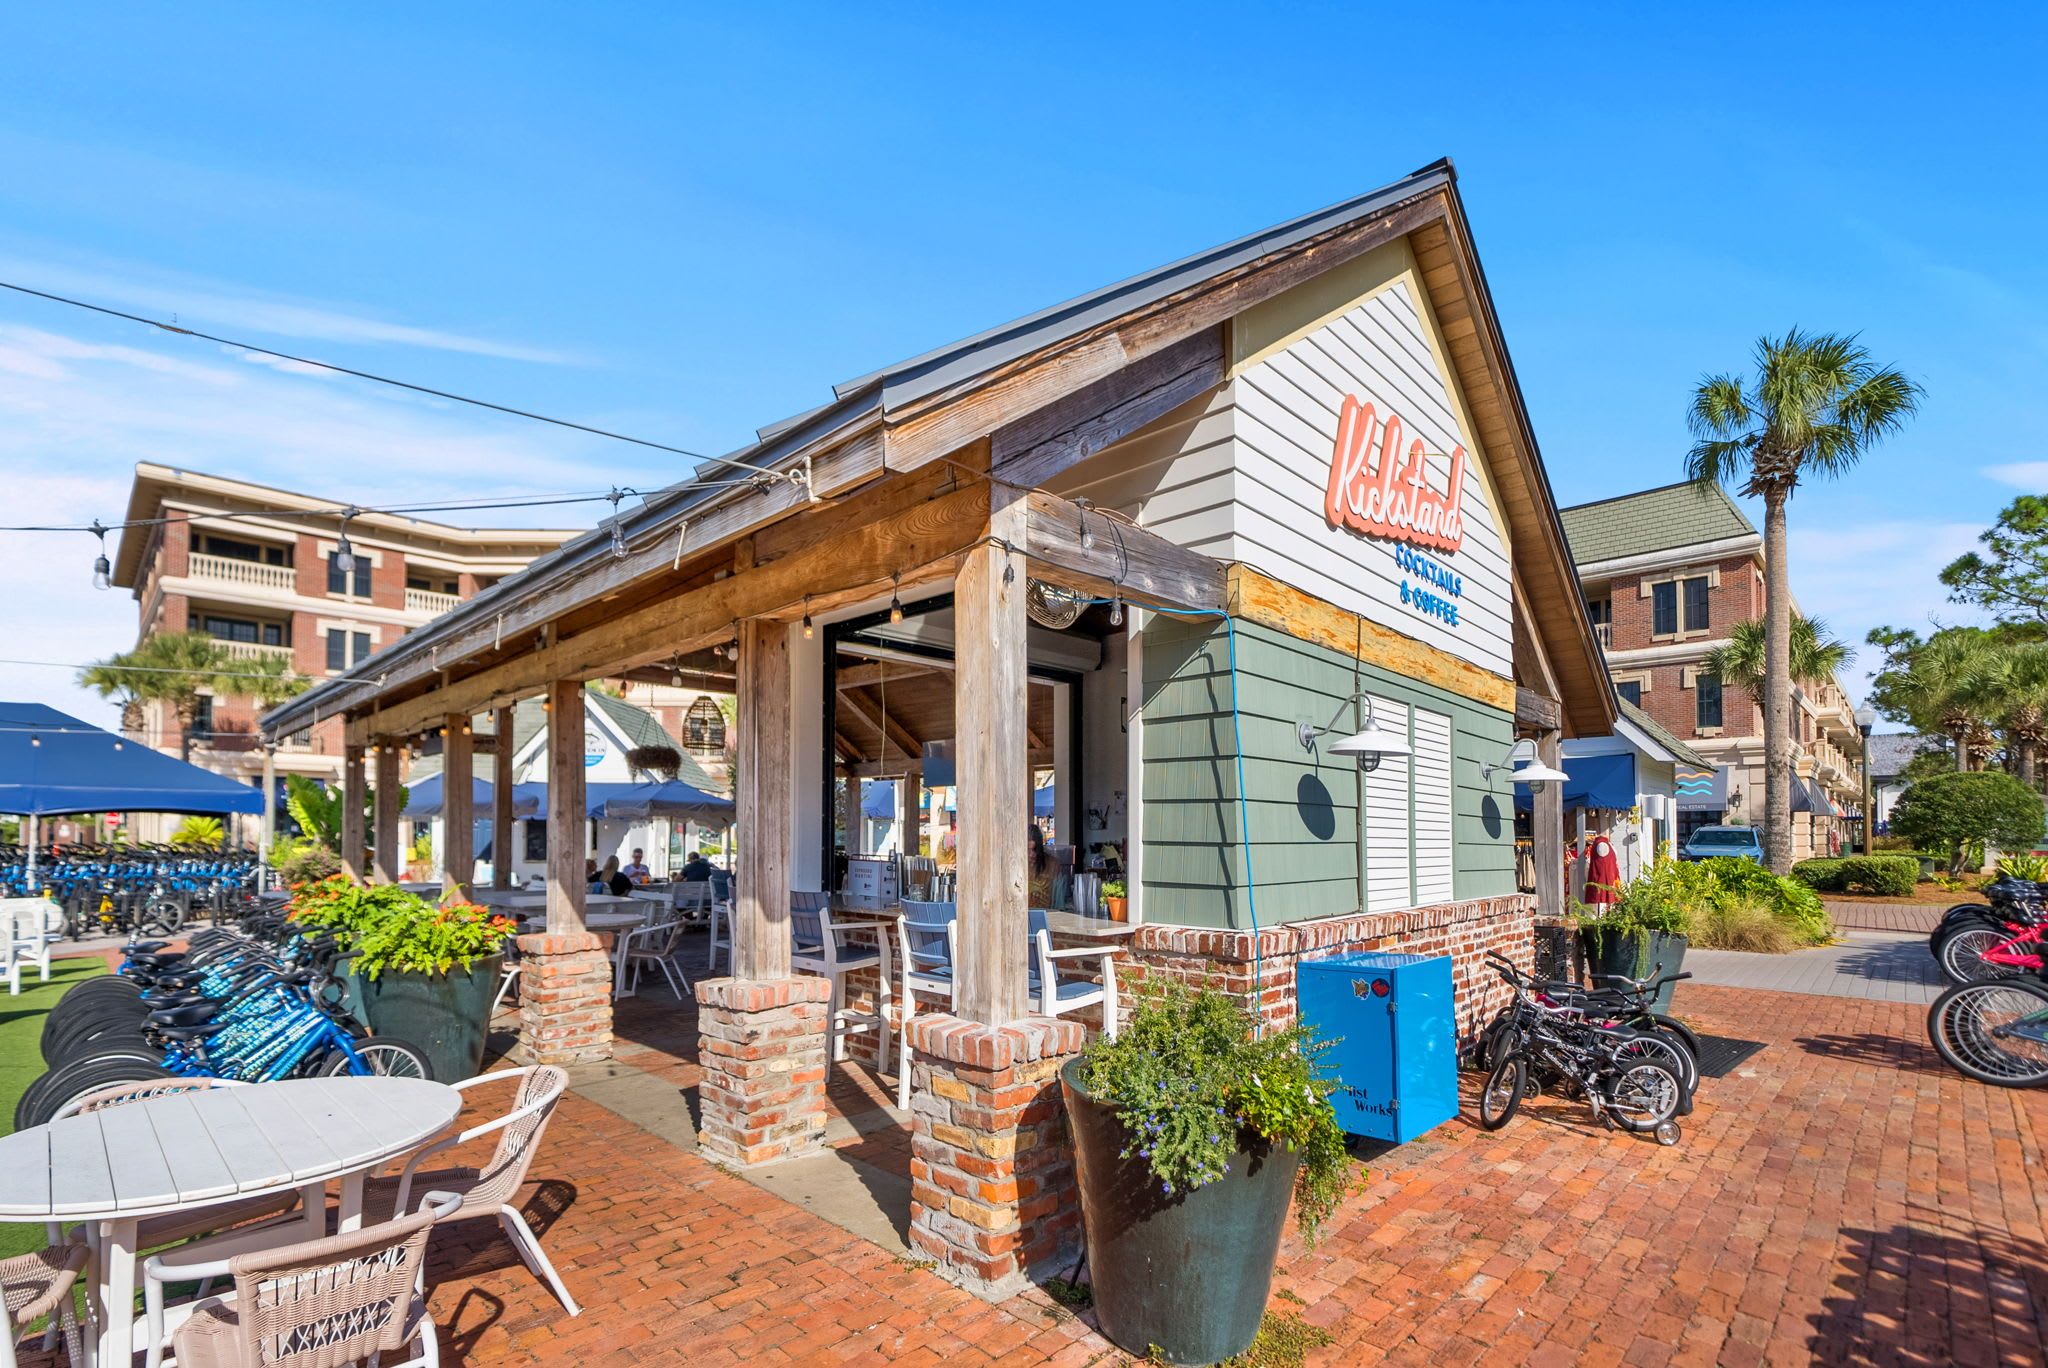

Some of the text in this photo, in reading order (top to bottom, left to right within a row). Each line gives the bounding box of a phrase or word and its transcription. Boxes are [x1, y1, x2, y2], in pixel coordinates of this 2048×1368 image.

[1334, 405, 1464, 541] Kickstand
[1396, 544, 1461, 596] COCKTAILS
[1401, 580, 1459, 627] & COFFEE
[1542, 1048, 1574, 1077] Peddlers 30A
[1354, 1099, 1393, 1117] Works
